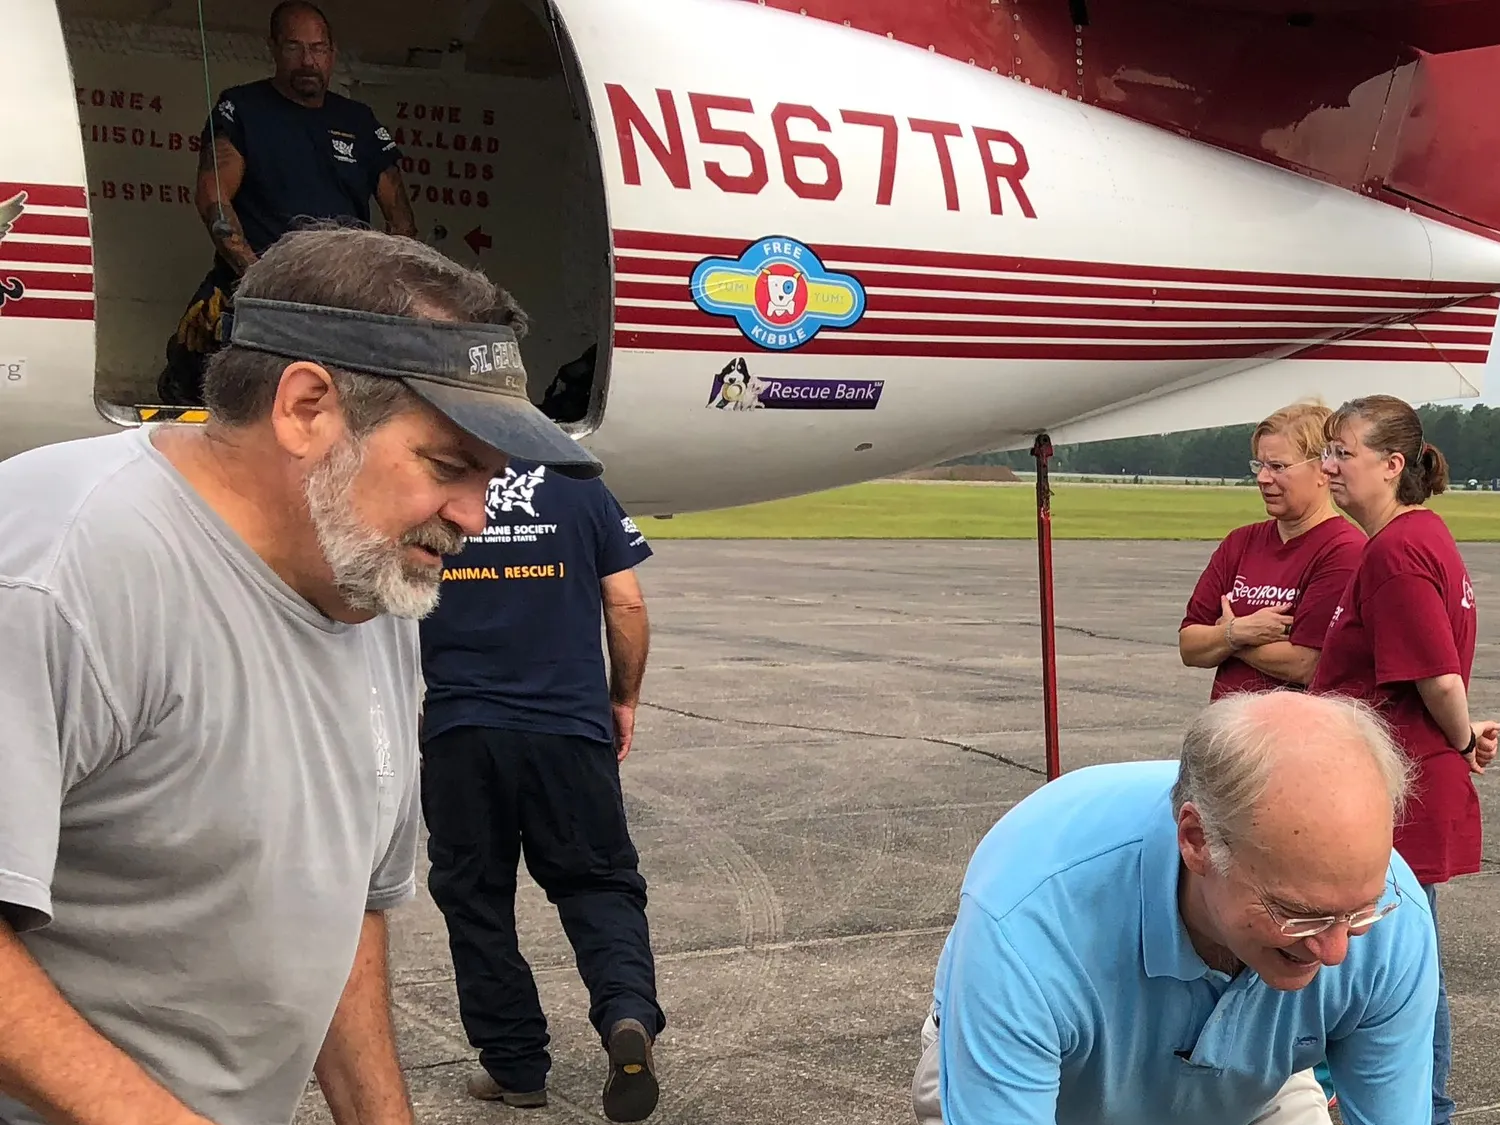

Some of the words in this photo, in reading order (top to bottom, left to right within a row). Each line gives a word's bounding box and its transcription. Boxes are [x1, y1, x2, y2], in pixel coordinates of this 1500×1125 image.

[396, 102, 461, 124] ZONE
[483, 110, 495, 126] 5
[604, 82, 1038, 219] N567TR
[448, 160, 494, 180] LBS
[763, 242, 803, 260] FREE
[751, 325, 807, 346] KIBBLE
[769, 382, 830, 399] Rescue
[834, 383, 876, 399] Bank
[513, 524, 557, 534] SOCIETY
[442, 567, 499, 580] ANIMAL
[504, 565, 555, 579] RESCUE
